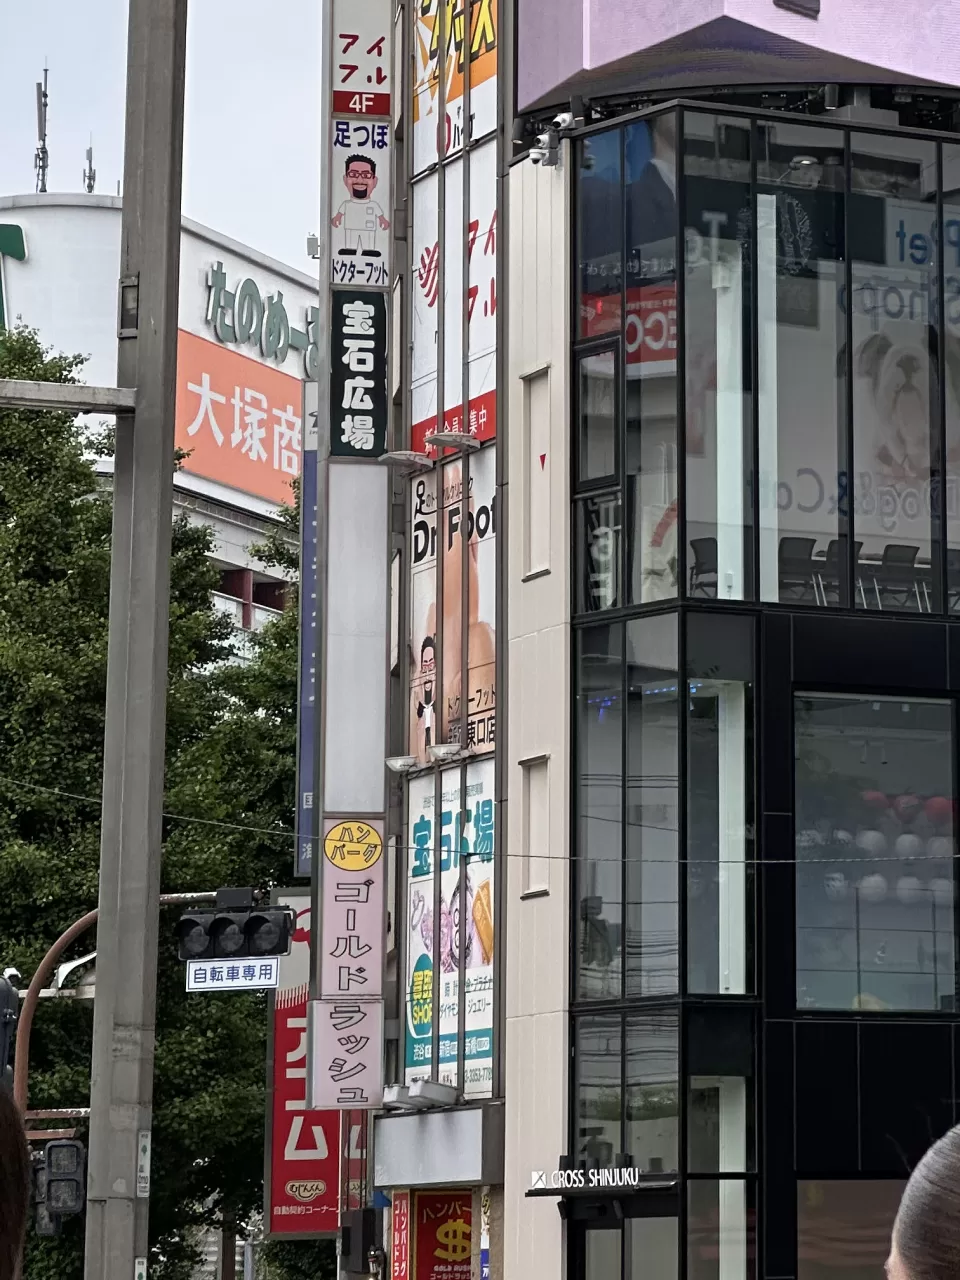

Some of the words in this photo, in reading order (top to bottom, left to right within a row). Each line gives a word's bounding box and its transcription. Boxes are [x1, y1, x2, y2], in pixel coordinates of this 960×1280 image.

[338, 33, 386, 58] アイ
[338, 64, 387, 86] フル
[348, 93, 375, 113] 4F
[333, 120, 388, 150] 足つぼ
[332, 259, 389, 285] ドクターフット
[341, 300, 375, 451] 宝石広場
[447, 684, 496, 714] ドクーフット
[447, 714, 496, 749] 新東口店
[193, 964, 274, 984] 自転車専用
[330, 879, 375, 1104] ゴールドラッシュ
[551, 1170, 585, 1188] CROSS
[589, 1167, 639, 1187] SHINJUKU
